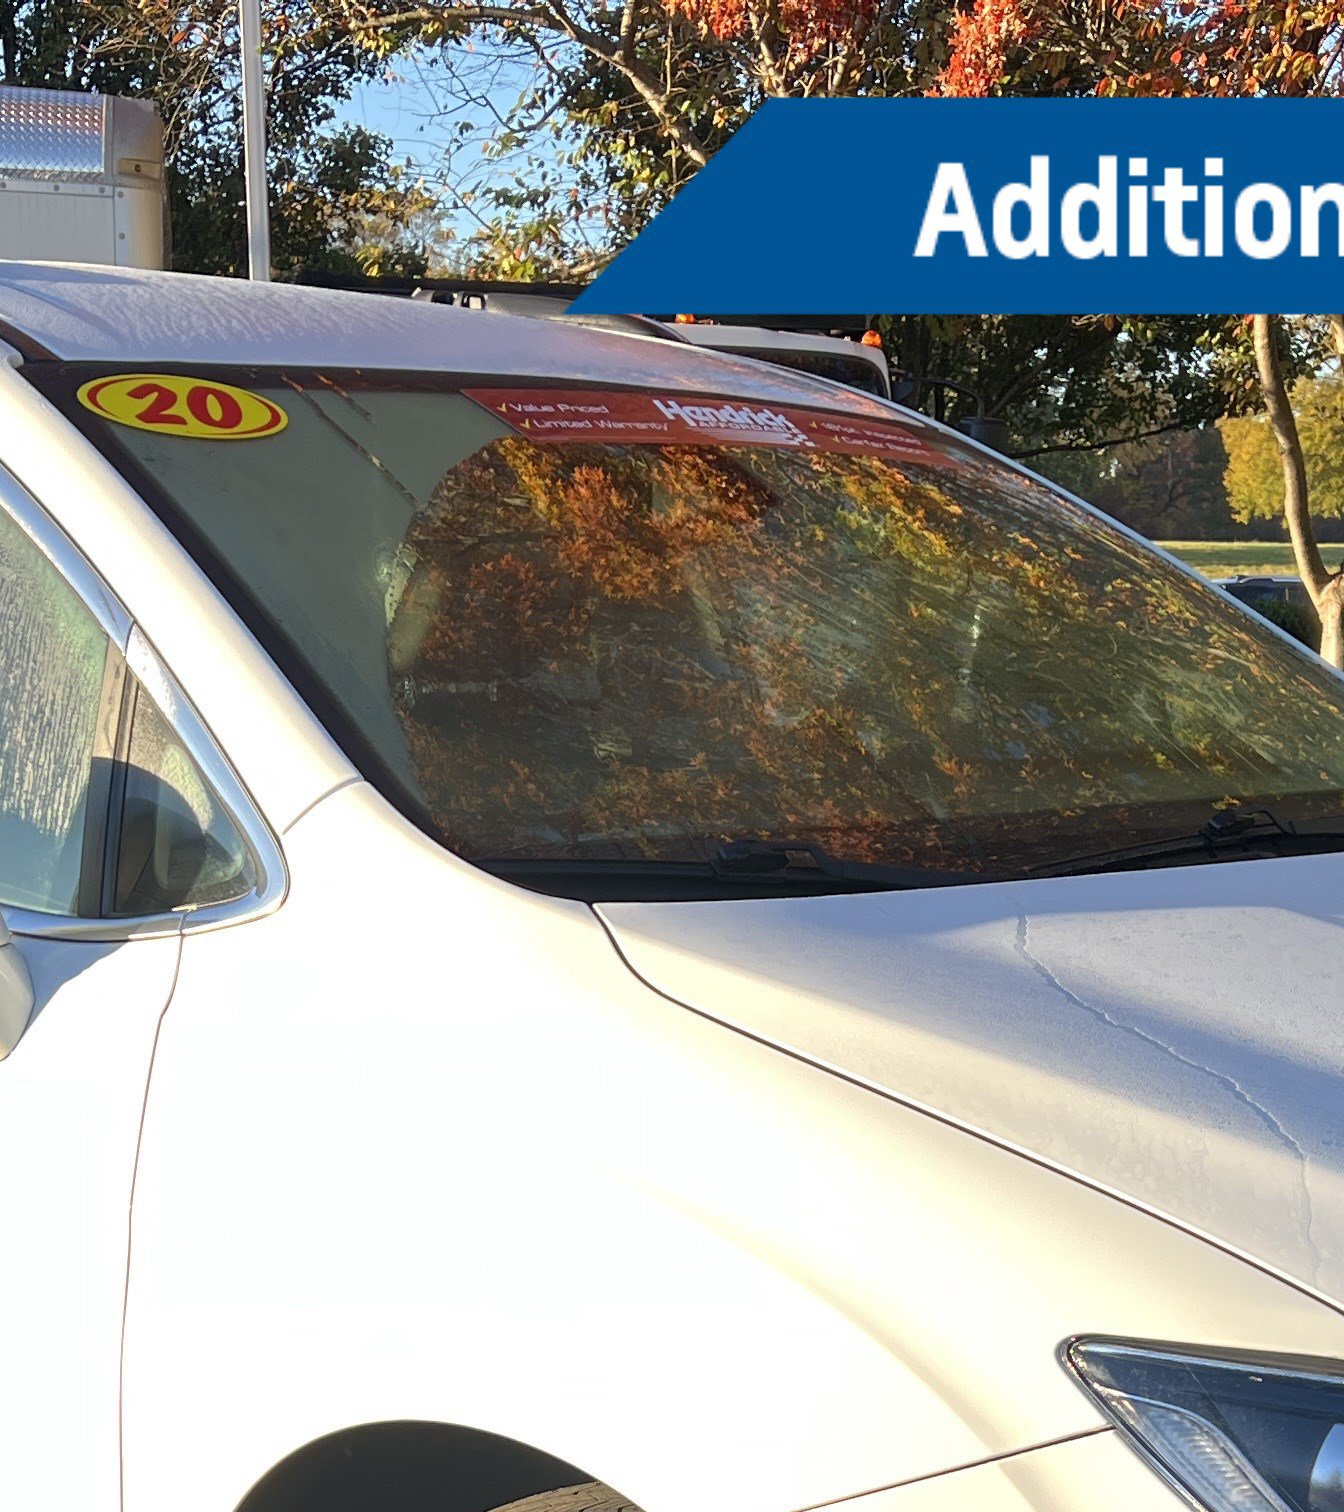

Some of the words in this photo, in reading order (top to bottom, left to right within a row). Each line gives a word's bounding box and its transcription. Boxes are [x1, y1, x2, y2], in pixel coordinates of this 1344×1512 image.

[126, 383, 243, 429] 20
[509, 402, 555, 413] Value
[652, 399, 796, 431] Hendrick
